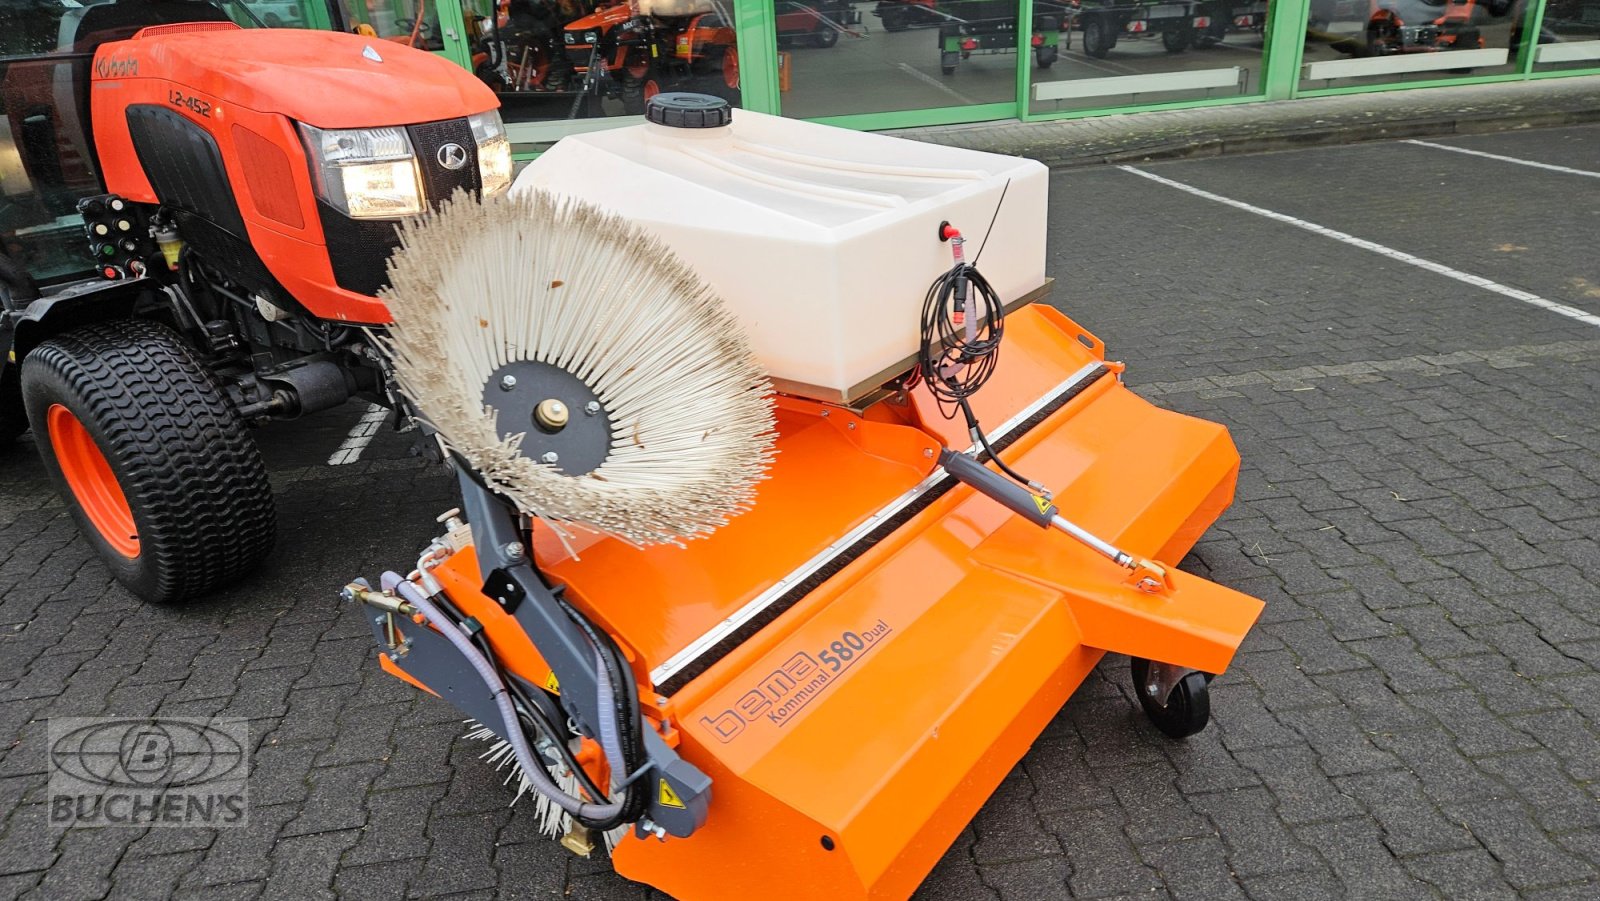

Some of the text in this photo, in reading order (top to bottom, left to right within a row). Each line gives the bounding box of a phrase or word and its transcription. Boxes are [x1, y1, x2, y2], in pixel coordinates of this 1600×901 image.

[169, 89, 211, 118] L2-452
[699, 651, 819, 744] bema
[767, 619, 889, 724] Kommunal 580 Dual
